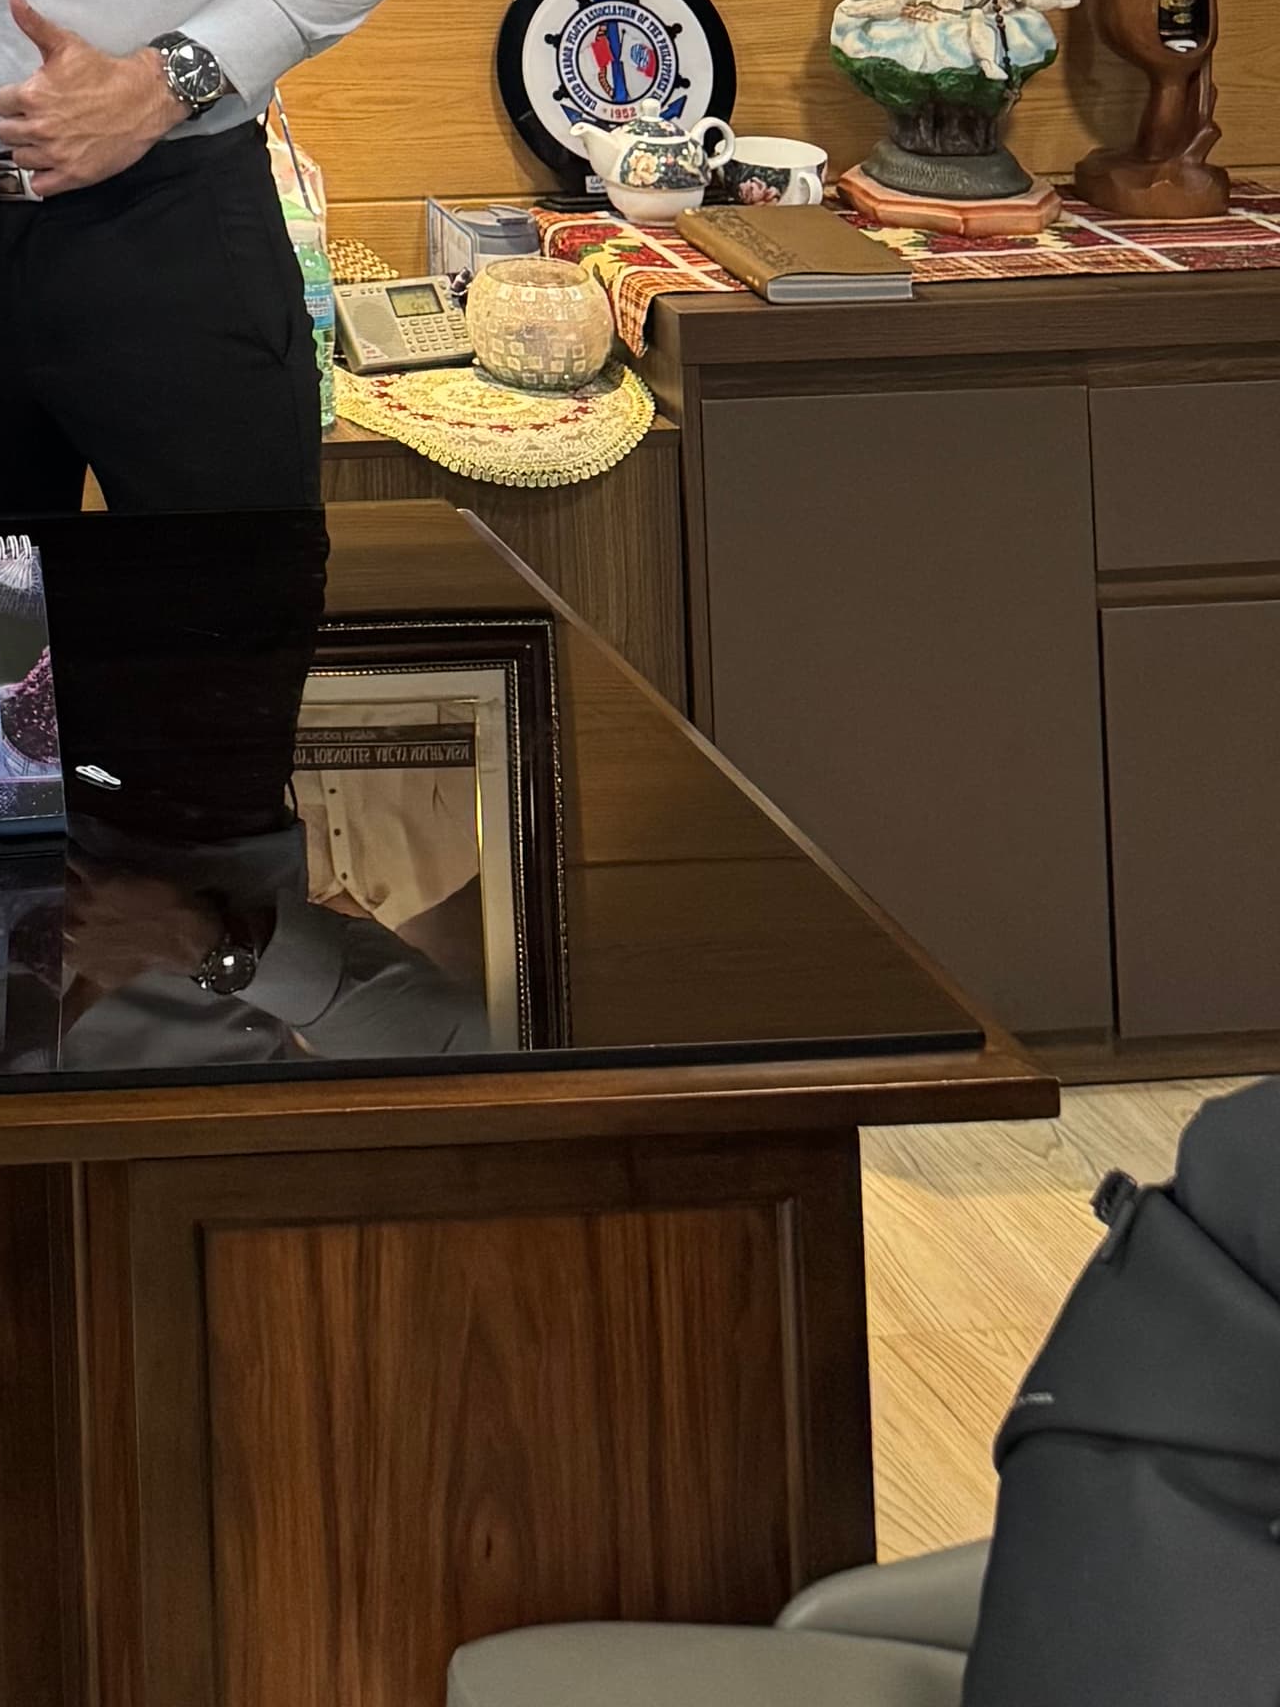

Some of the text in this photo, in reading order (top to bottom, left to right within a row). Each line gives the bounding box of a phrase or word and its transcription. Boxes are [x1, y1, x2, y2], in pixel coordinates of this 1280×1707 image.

[585, 4, 637, 23] ASSOCIATION
[637, 13, 648, 26] OF
[647, 21, 663, 40] THE
[609, 106, 638, 118] 1952
